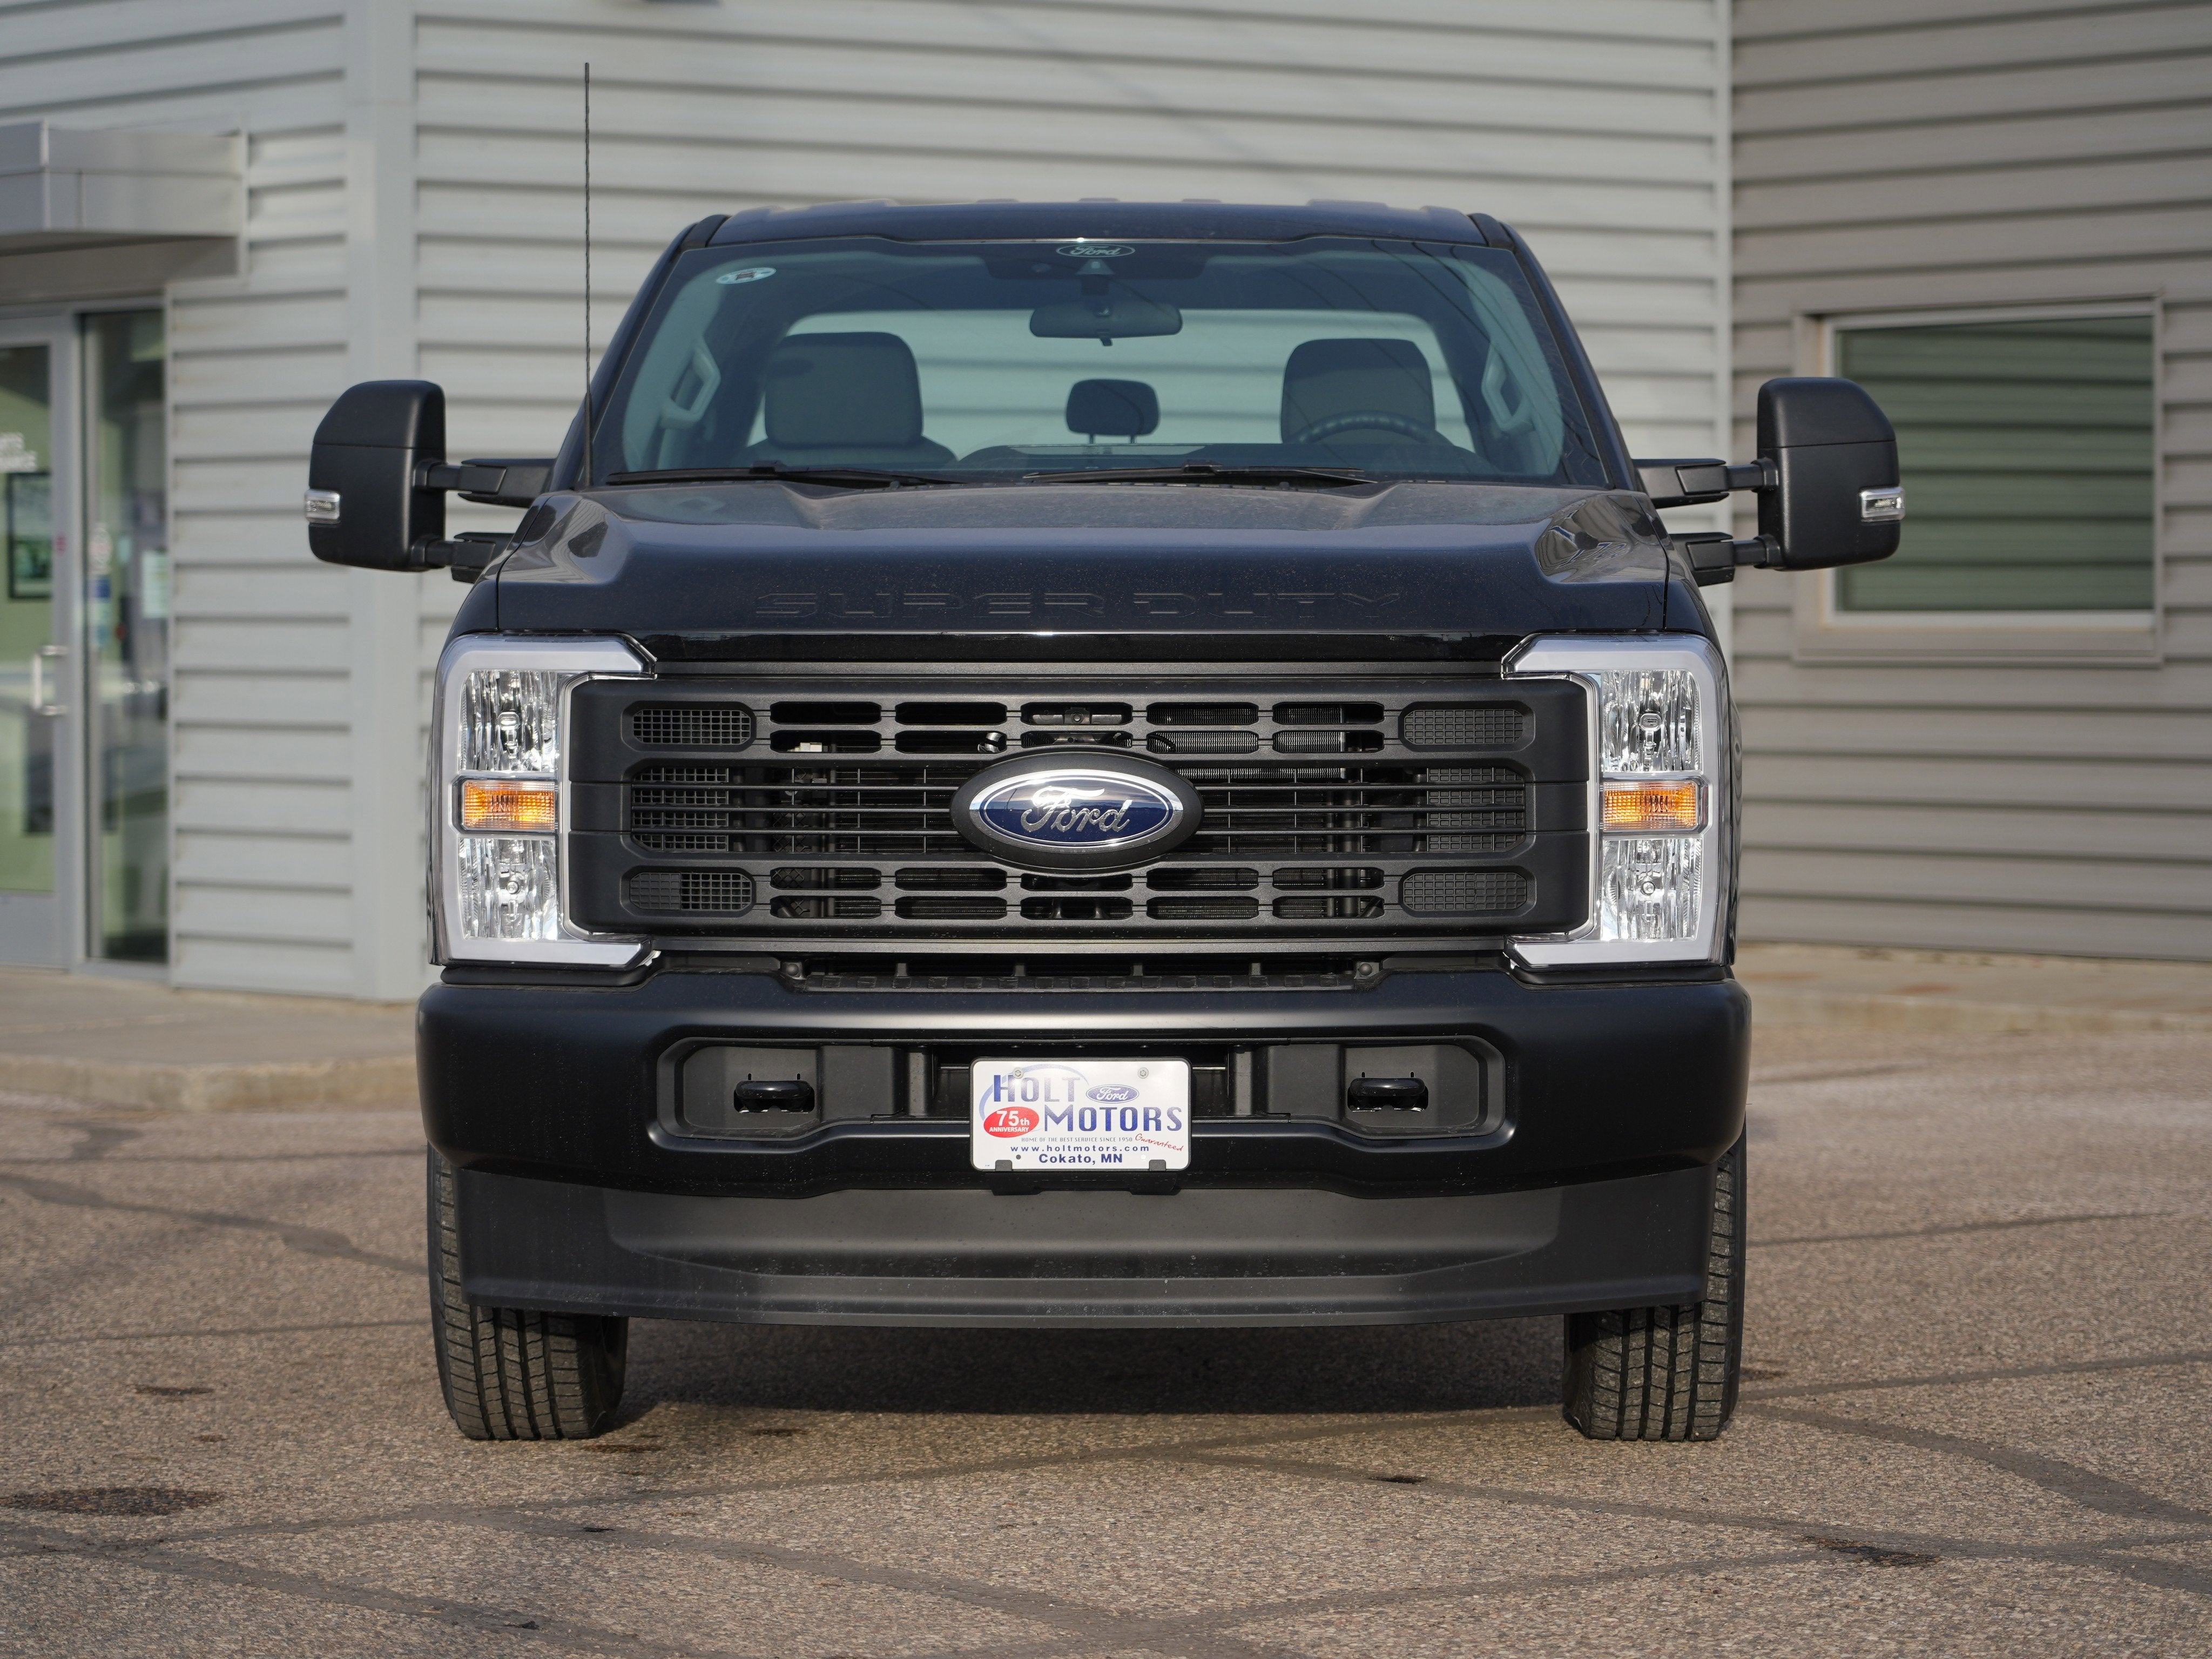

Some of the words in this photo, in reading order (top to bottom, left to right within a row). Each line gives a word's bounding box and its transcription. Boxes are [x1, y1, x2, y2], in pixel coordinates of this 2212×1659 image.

[1070, 246, 1121, 255] Ford
[755, 593, 1104, 618] SUPER
[1134, 593, 1400, 618] DUTY
[1021, 786, 1133, 833] Ford
[993, 1074, 1080, 1102] HOLT
[1096, 1087, 1130, 1101] Ford
[996, 1110, 1030, 1127] 75th
[1044, 1104, 1182, 1132] MOTORS
[1135, 1133, 1184, 1152] Guaranteed
[1038, 1154, 1096, 1165] Cokato,
[1101, 1154, 1123, 1163] MN
